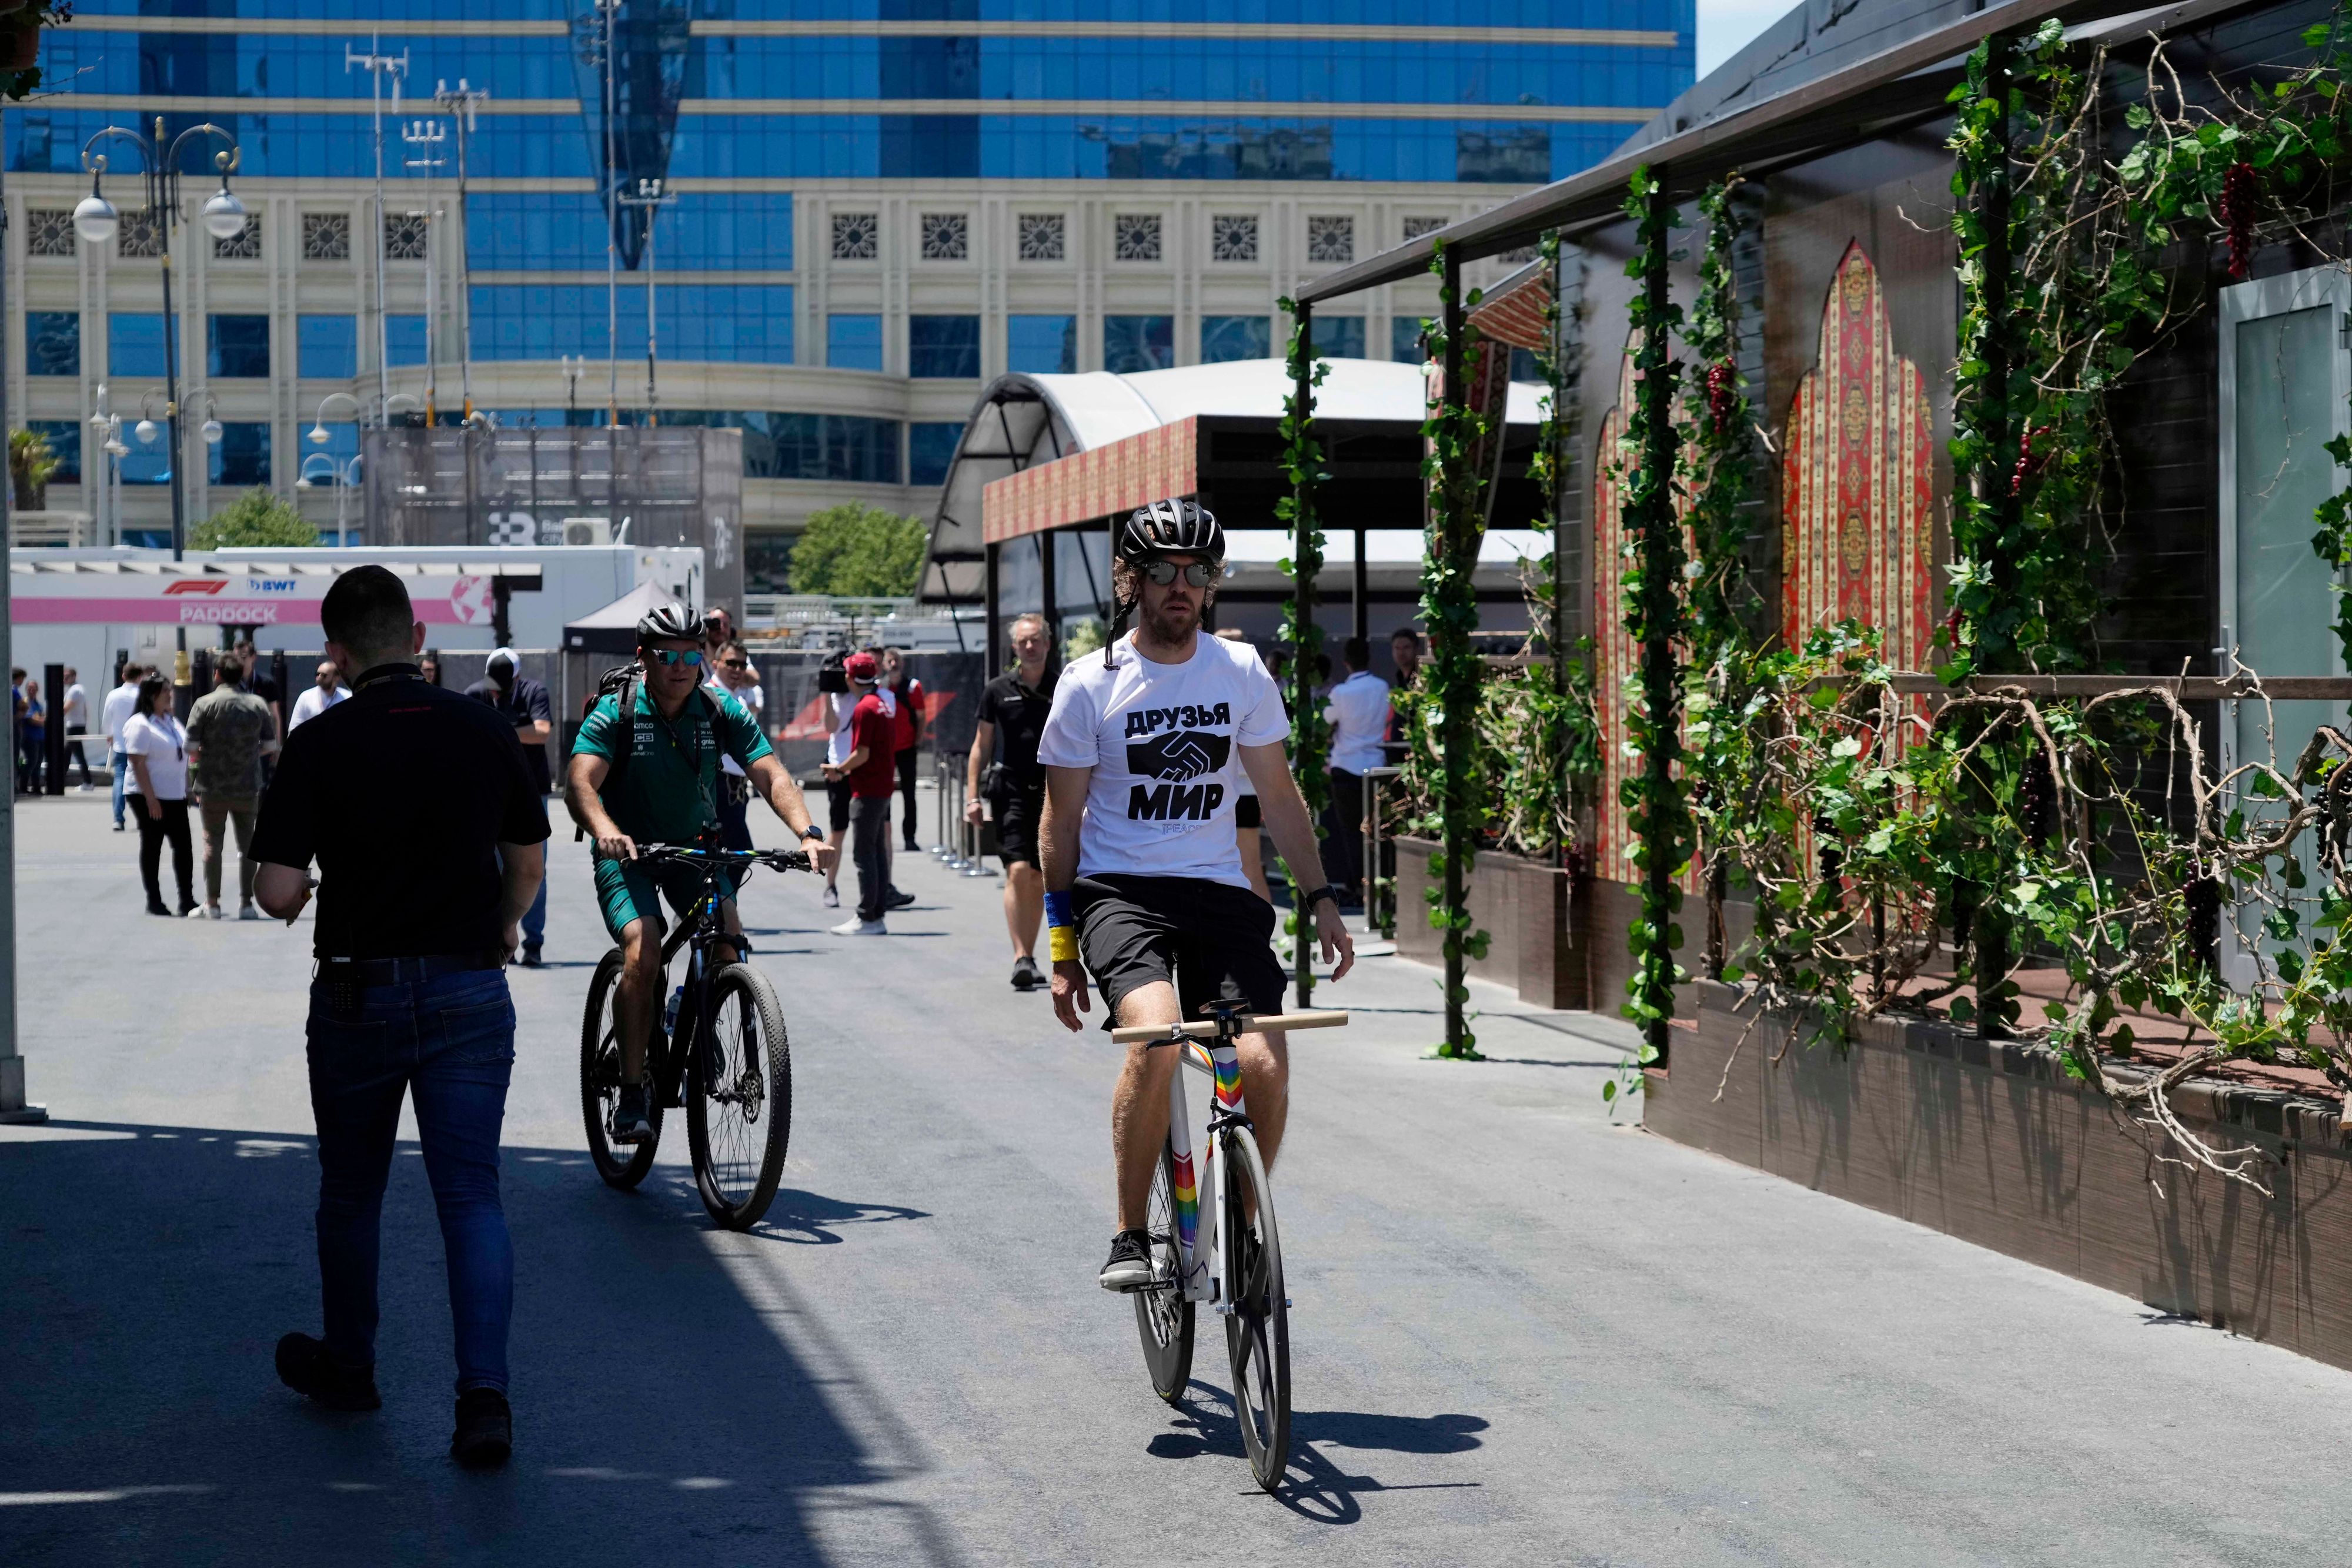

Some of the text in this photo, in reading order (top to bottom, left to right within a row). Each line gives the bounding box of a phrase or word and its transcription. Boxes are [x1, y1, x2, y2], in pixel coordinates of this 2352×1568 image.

[262, 580, 296, 591] BWT
[180, 606, 277, 622] PADDOCK
[1124, 702, 1231, 738] ДРУЗЬЯ
[633, 733, 654, 743] CB
[1127, 783, 1224, 821] МИР
